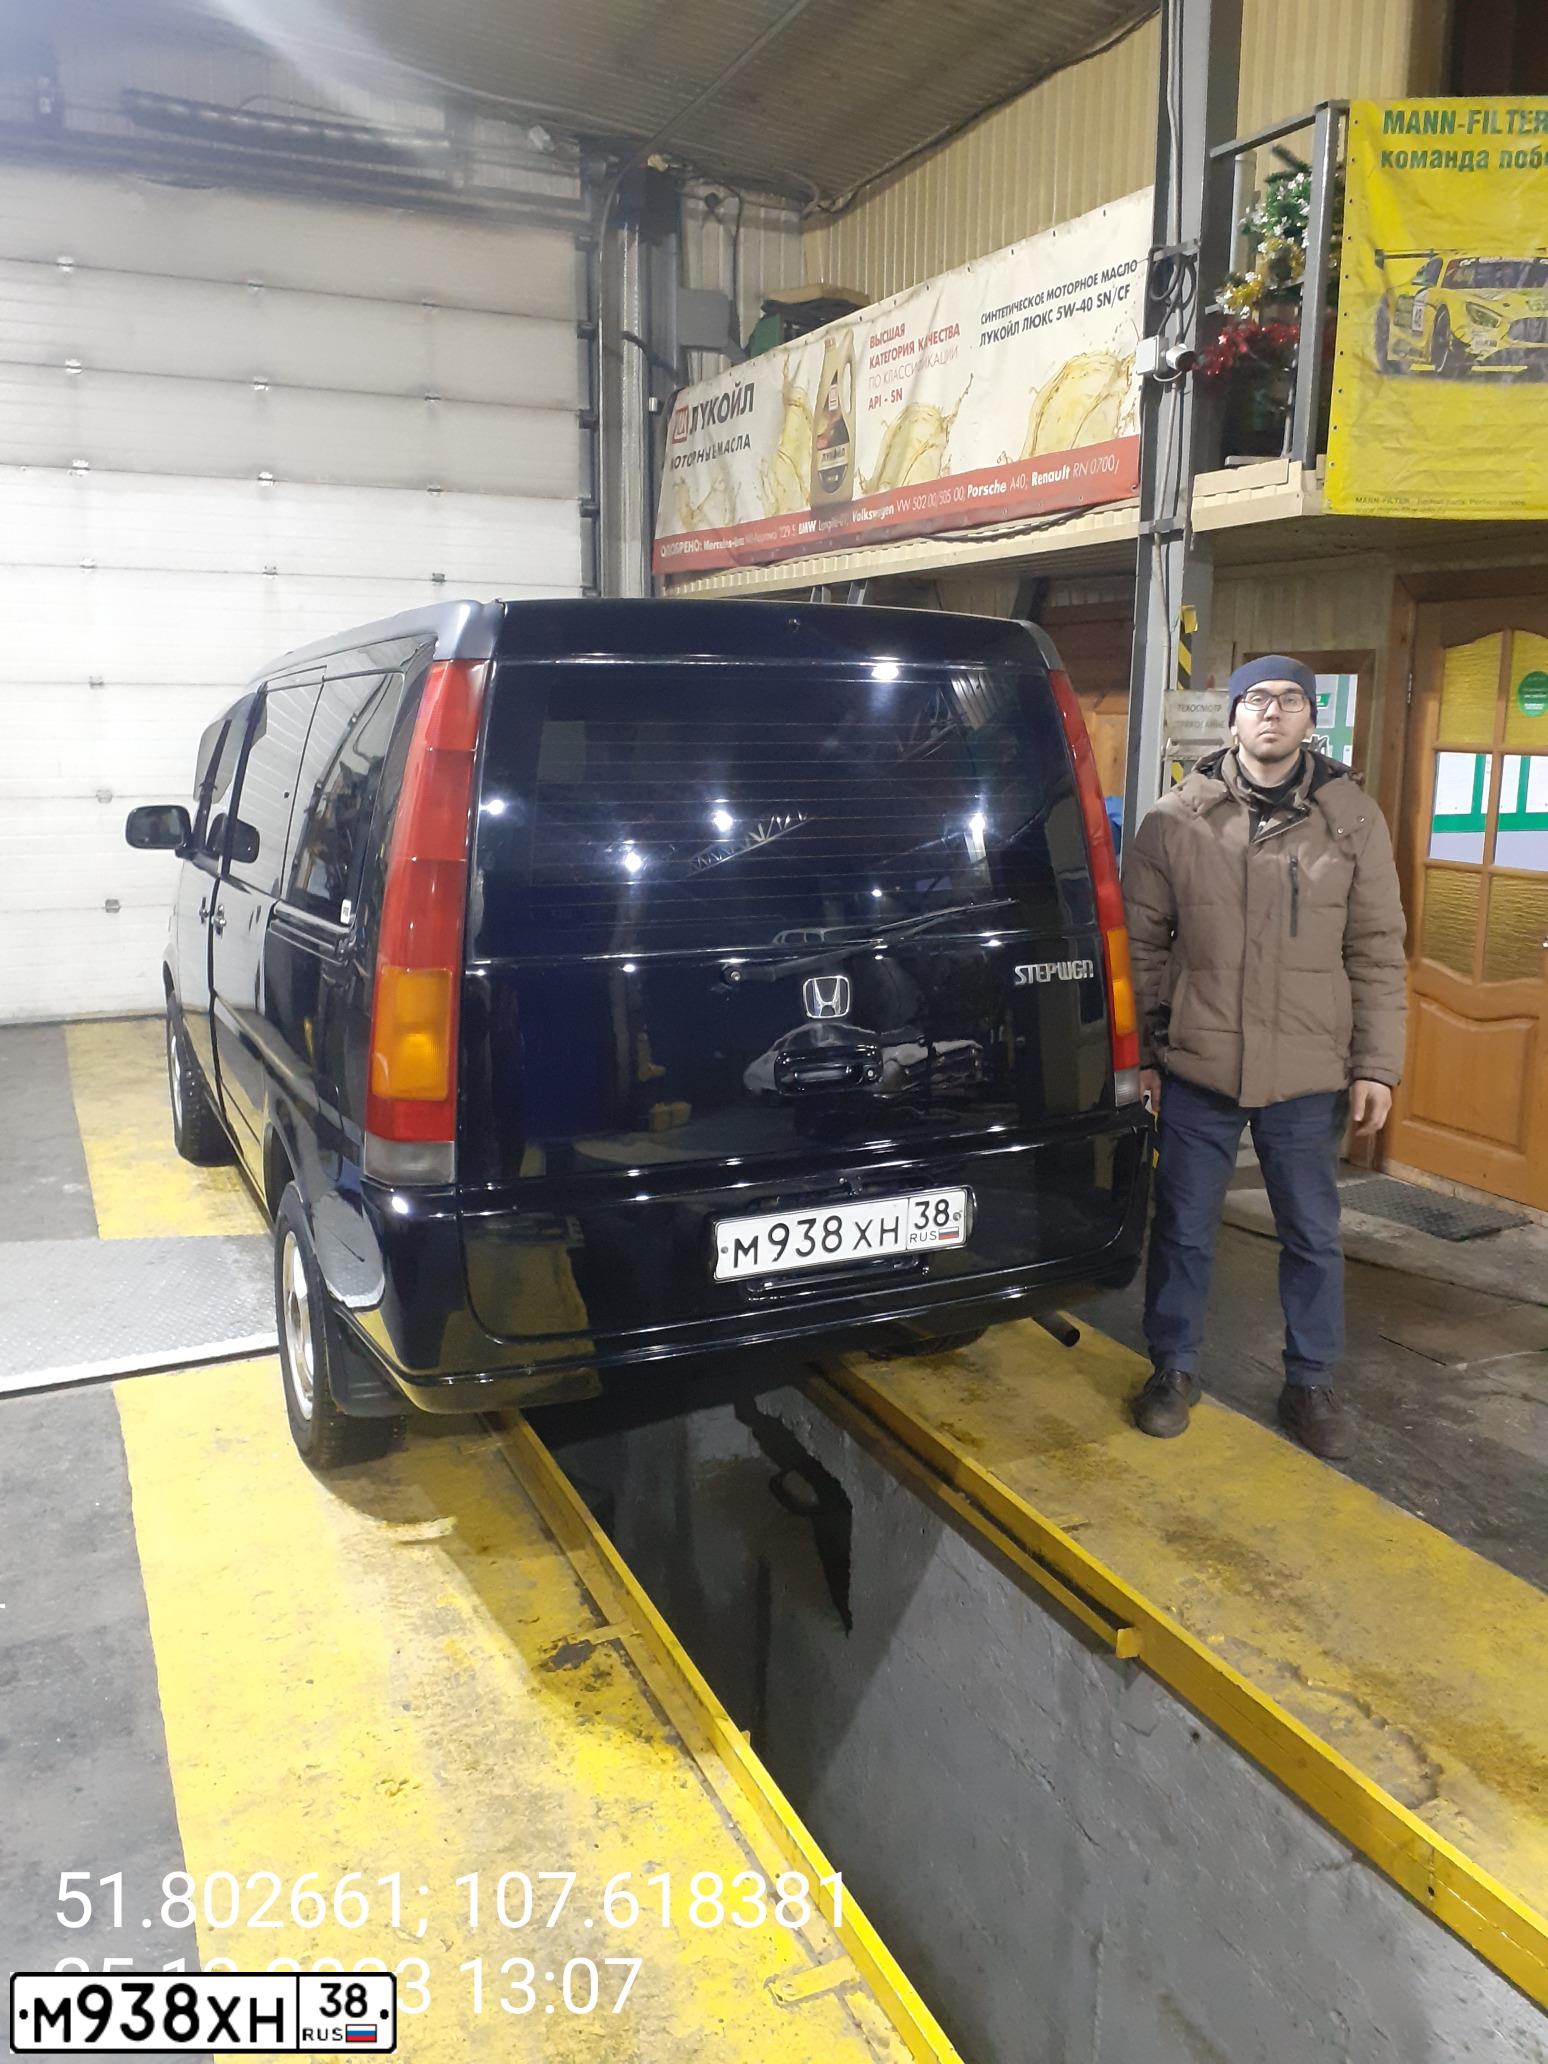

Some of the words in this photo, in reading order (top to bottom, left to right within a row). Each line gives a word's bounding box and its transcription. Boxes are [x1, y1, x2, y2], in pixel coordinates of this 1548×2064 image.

[1384, 109, 1548, 135] MANN-FILTER
[1381, 149, 1489, 172] команда
[980, 292, 1045, 325] СИНТЕТИЧЕСКОЕ
[1046, 273, 1098, 301] МОТОРНОЕ
[1100, 259, 1138, 284] МАСЛО
[979, 320, 1020, 348] ЛУКОЙЛ
[1021, 309, 1054, 333] ЛЮКС
[1056, 296, 1094, 321] 5W-40
[1096, 283, 1131, 309] SN/CF
[869, 323, 905, 349] ВЫСШАЯ
[869, 340, 915, 370] КАТЕГОРИЯ
[918, 323, 960, 352] КАЧЕСТВА
[689, 381, 755, 435] ЛУКОЙЛ
[868, 395, 882, 411] API
[890, 388, 903, 403] SN
[798, 520, 817, 535] BMW
[967, 479, 1007, 499] Porsche
[1031, 465, 1071, 487] Renault
[1073, 460, 1089, 478] RN
[914, 1198, 950, 1230] 38
[909, 1230, 937, 1244] RUS
